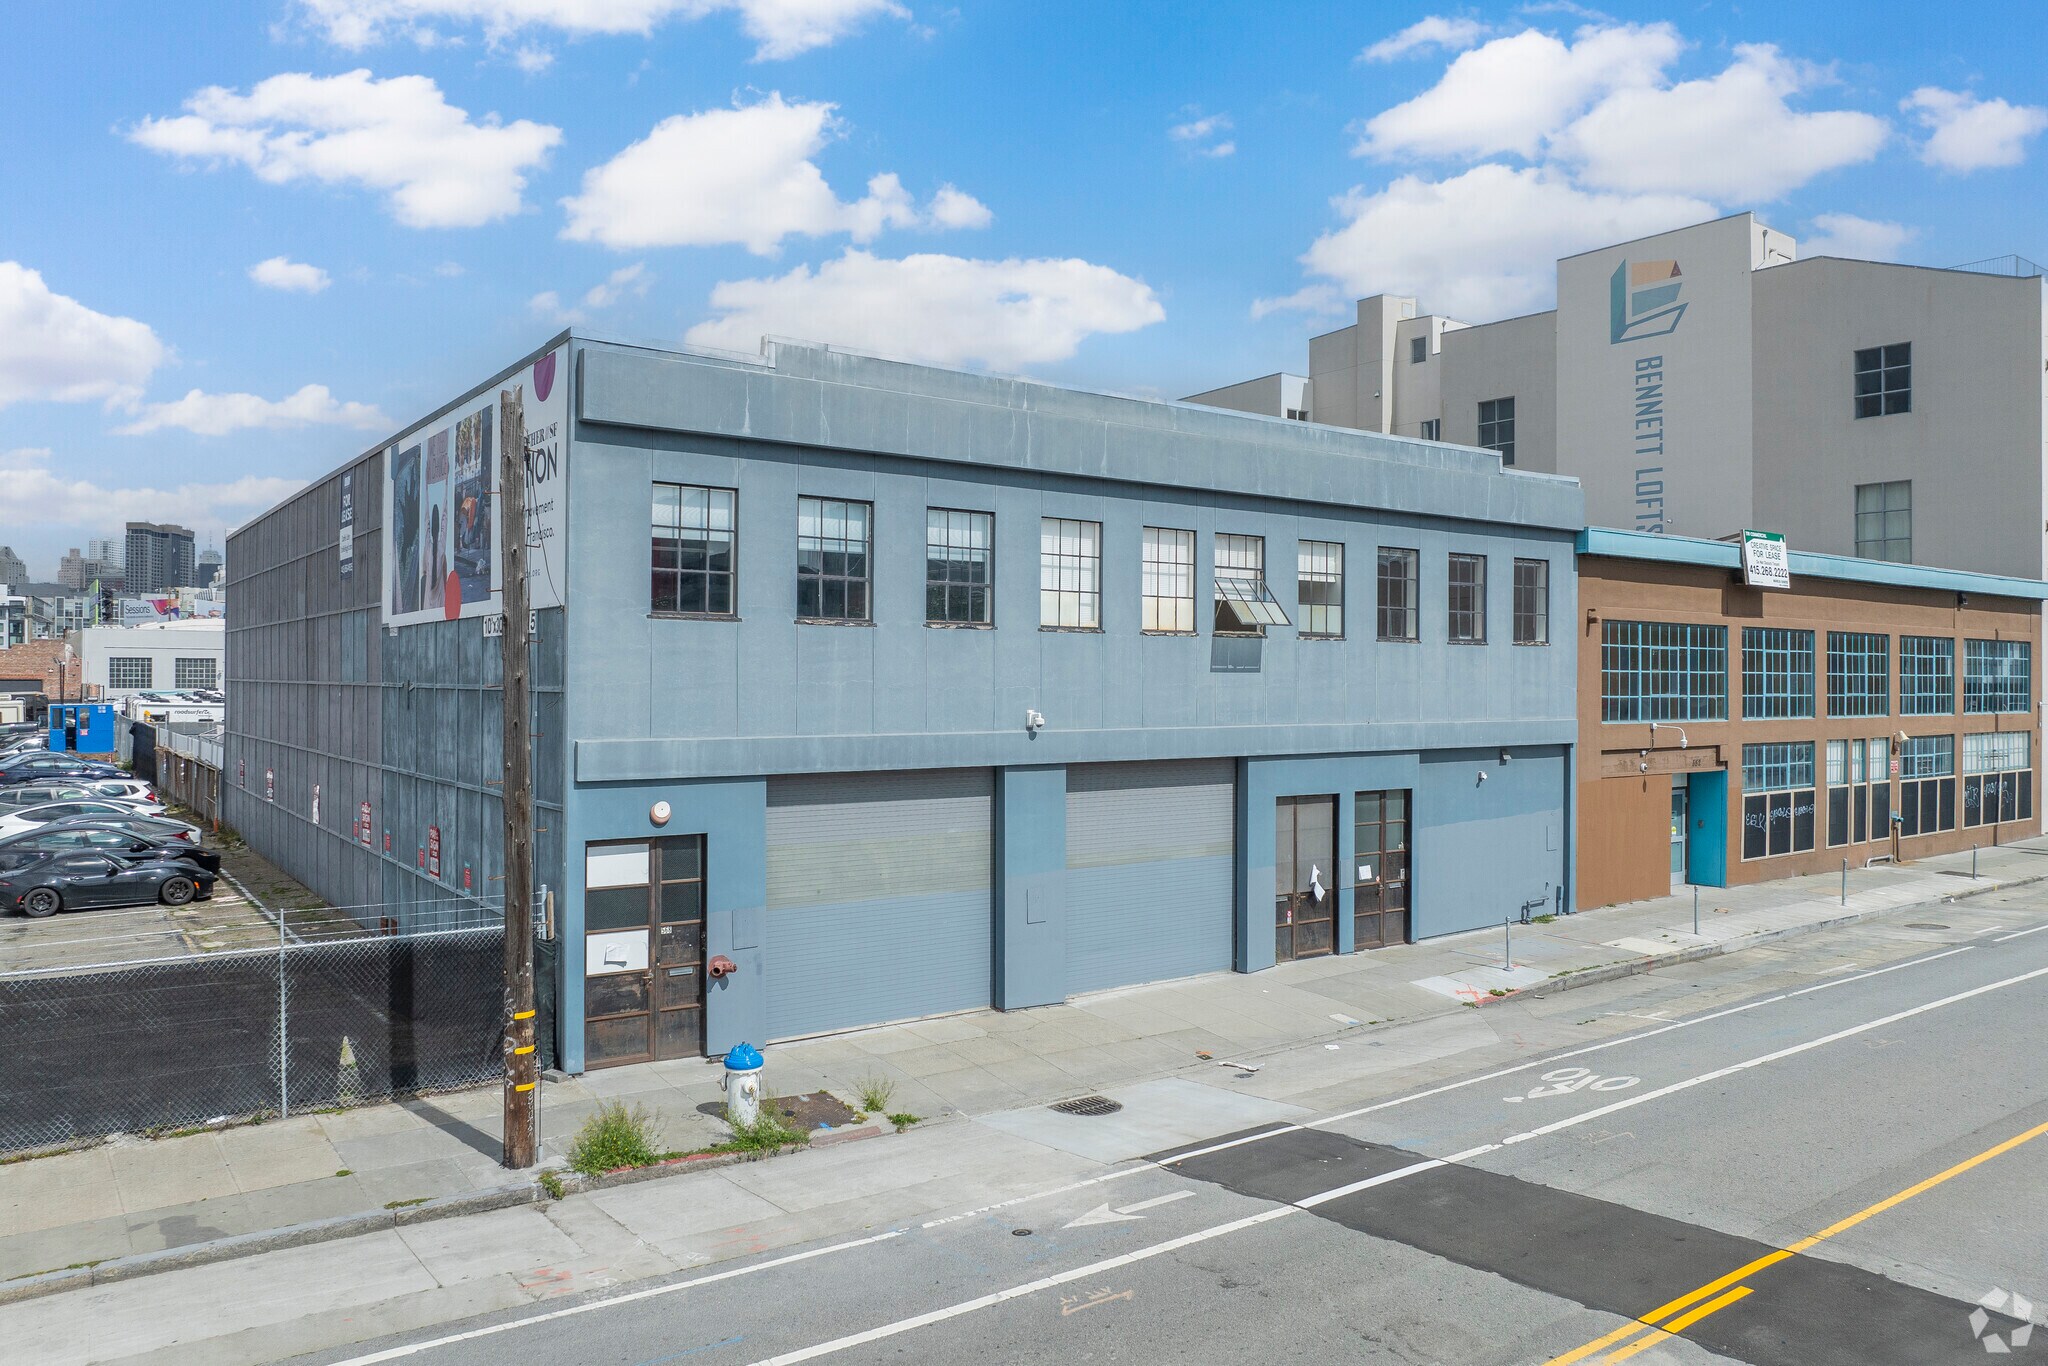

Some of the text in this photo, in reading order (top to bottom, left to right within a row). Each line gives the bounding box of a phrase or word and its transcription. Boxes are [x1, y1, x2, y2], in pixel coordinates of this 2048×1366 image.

[1635, 355, 1663, 455] BENNETT
[1751, 541, 1782, 552] CREATIVE SPACE
[1753, 549, 1781, 561] FOR LEASE
[1749, 565, 1788, 578] 415.268.2222
[125, 604, 151, 614] Sessions
